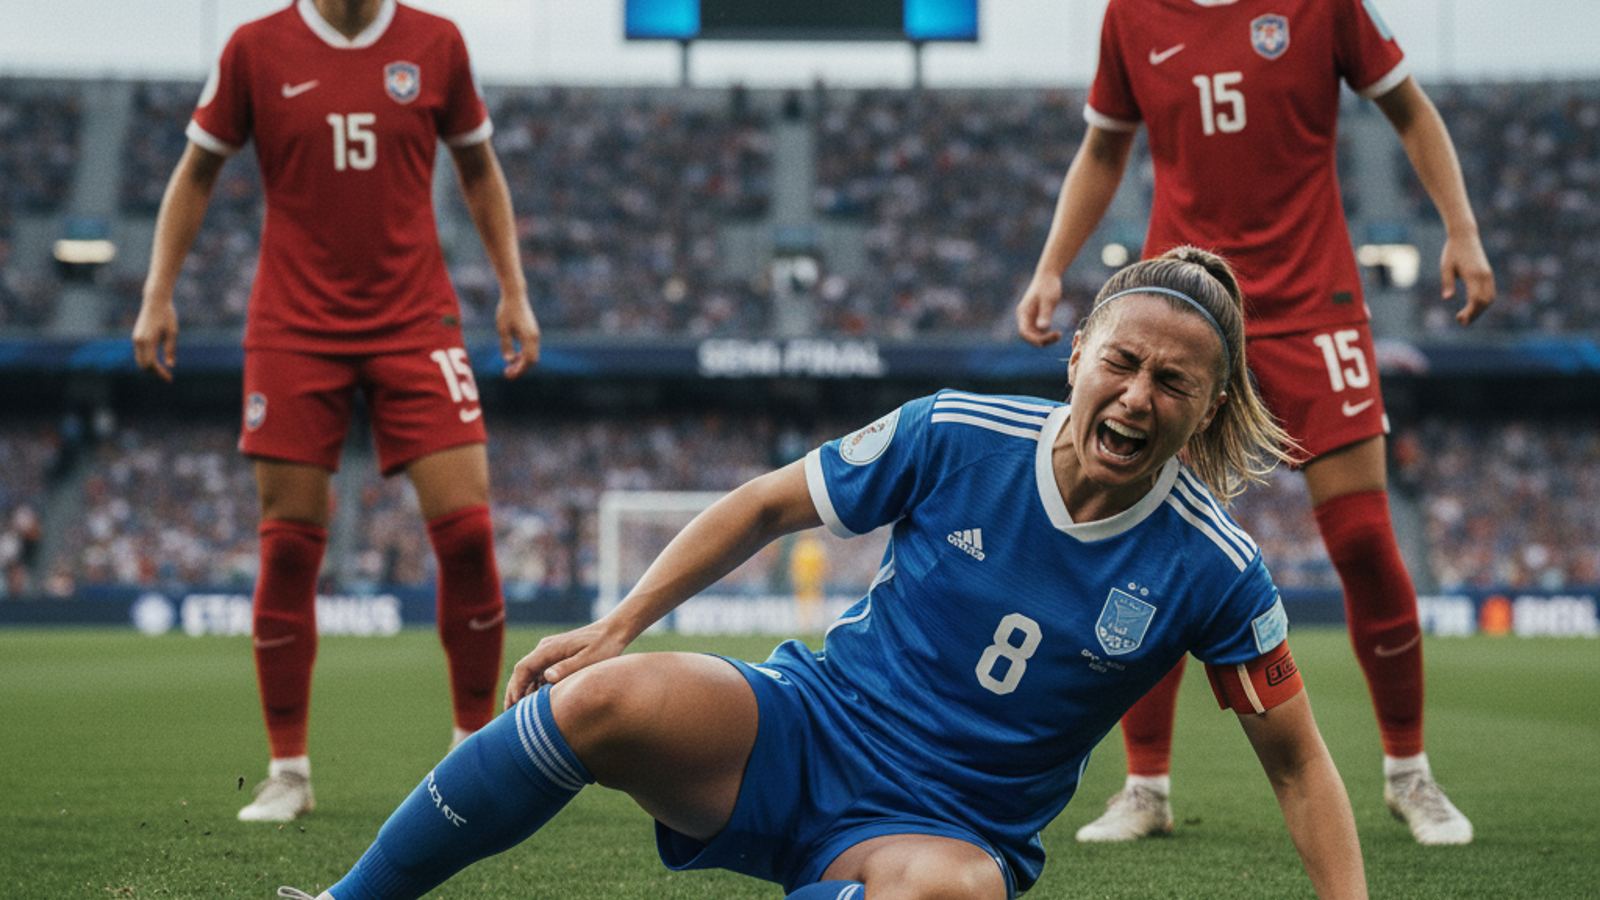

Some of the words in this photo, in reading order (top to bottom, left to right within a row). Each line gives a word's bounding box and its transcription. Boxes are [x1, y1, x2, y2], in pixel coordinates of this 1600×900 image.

[1192, 70, 1246, 135] 15
[326, 112, 377, 171] 15
[430, 346, 479, 403] 15
[783, 339, 886, 378] FINAL
[1313, 329, 1370, 392] 15
[975, 612, 1043, 696] 8
